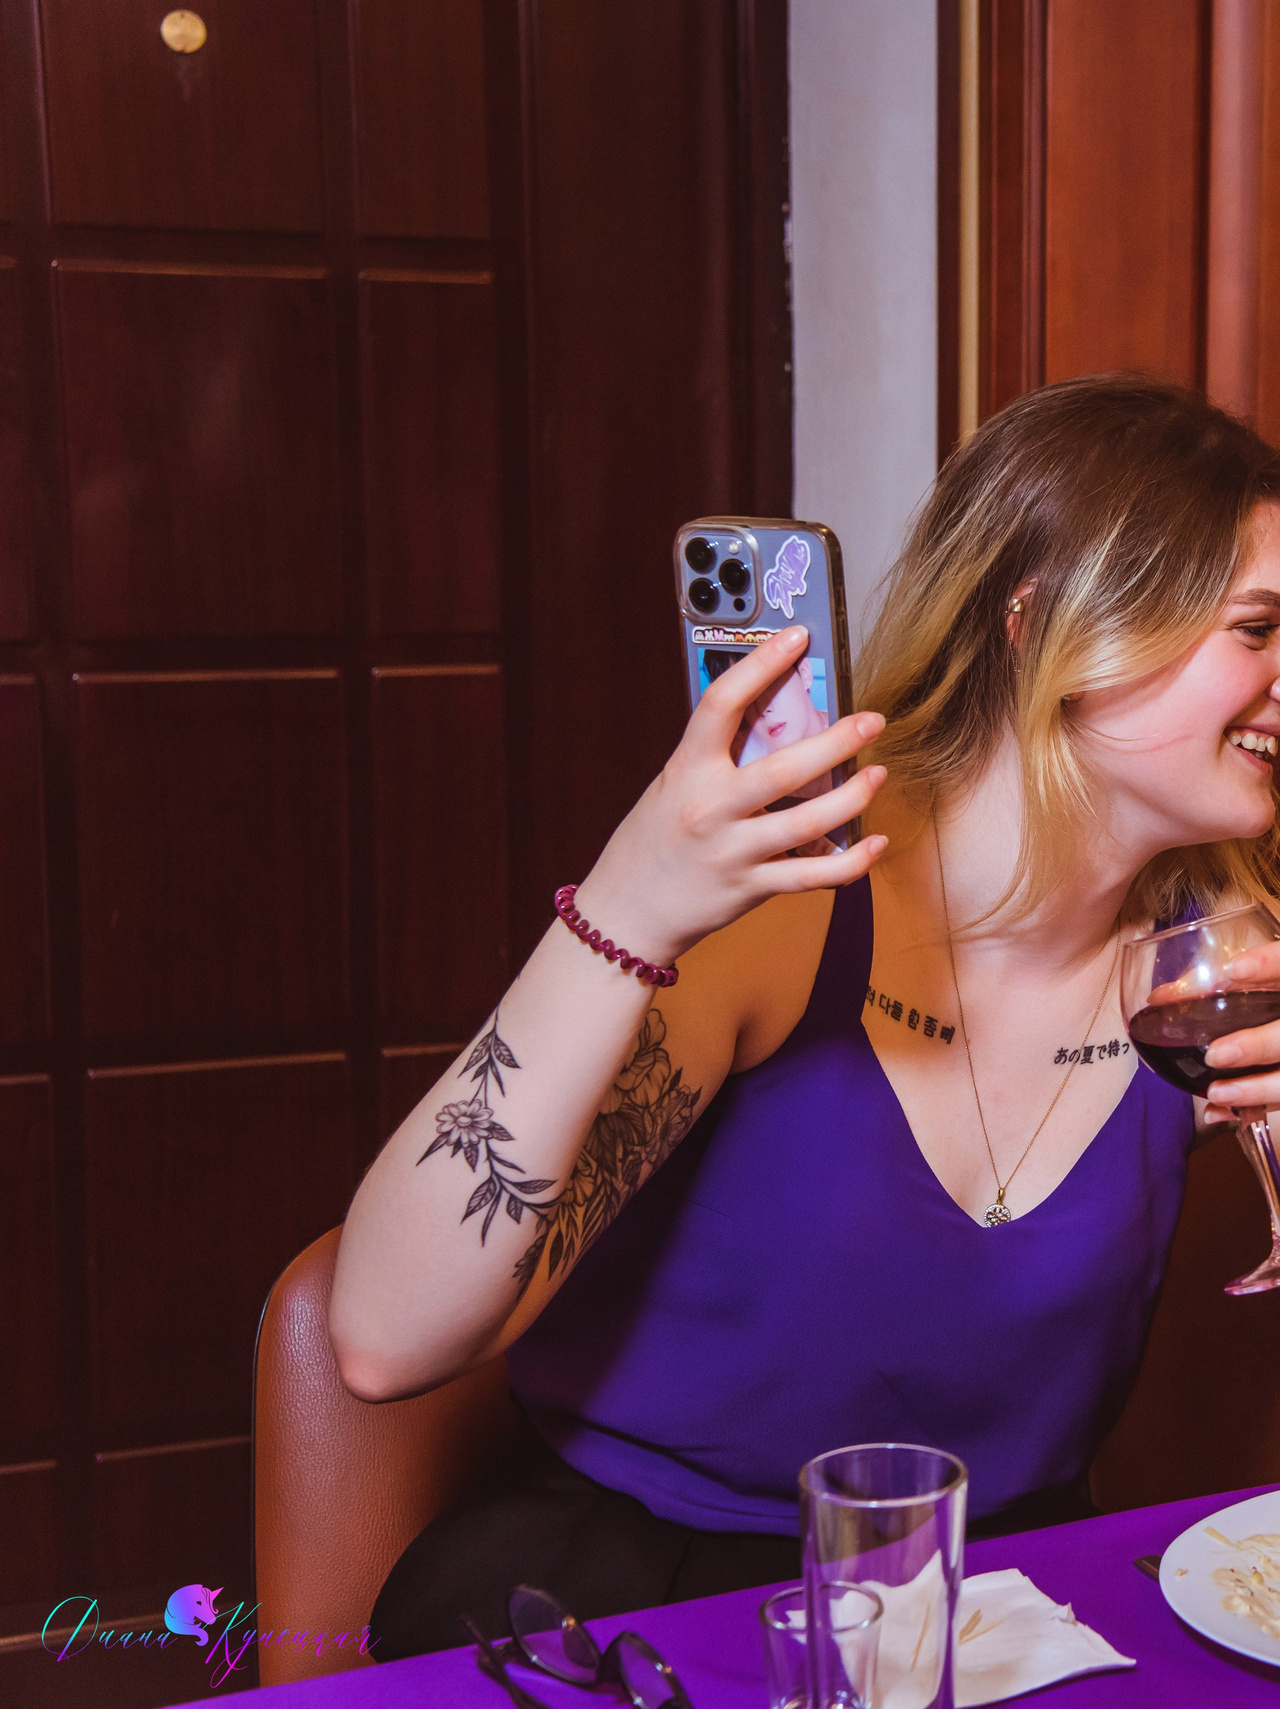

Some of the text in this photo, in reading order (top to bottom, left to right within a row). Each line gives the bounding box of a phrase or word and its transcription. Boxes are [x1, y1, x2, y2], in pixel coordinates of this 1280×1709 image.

[878, 993, 904, 1022] 다들
[907, 1008, 920, 1031] 힘
[923, 1015, 939, 1038] 좀
